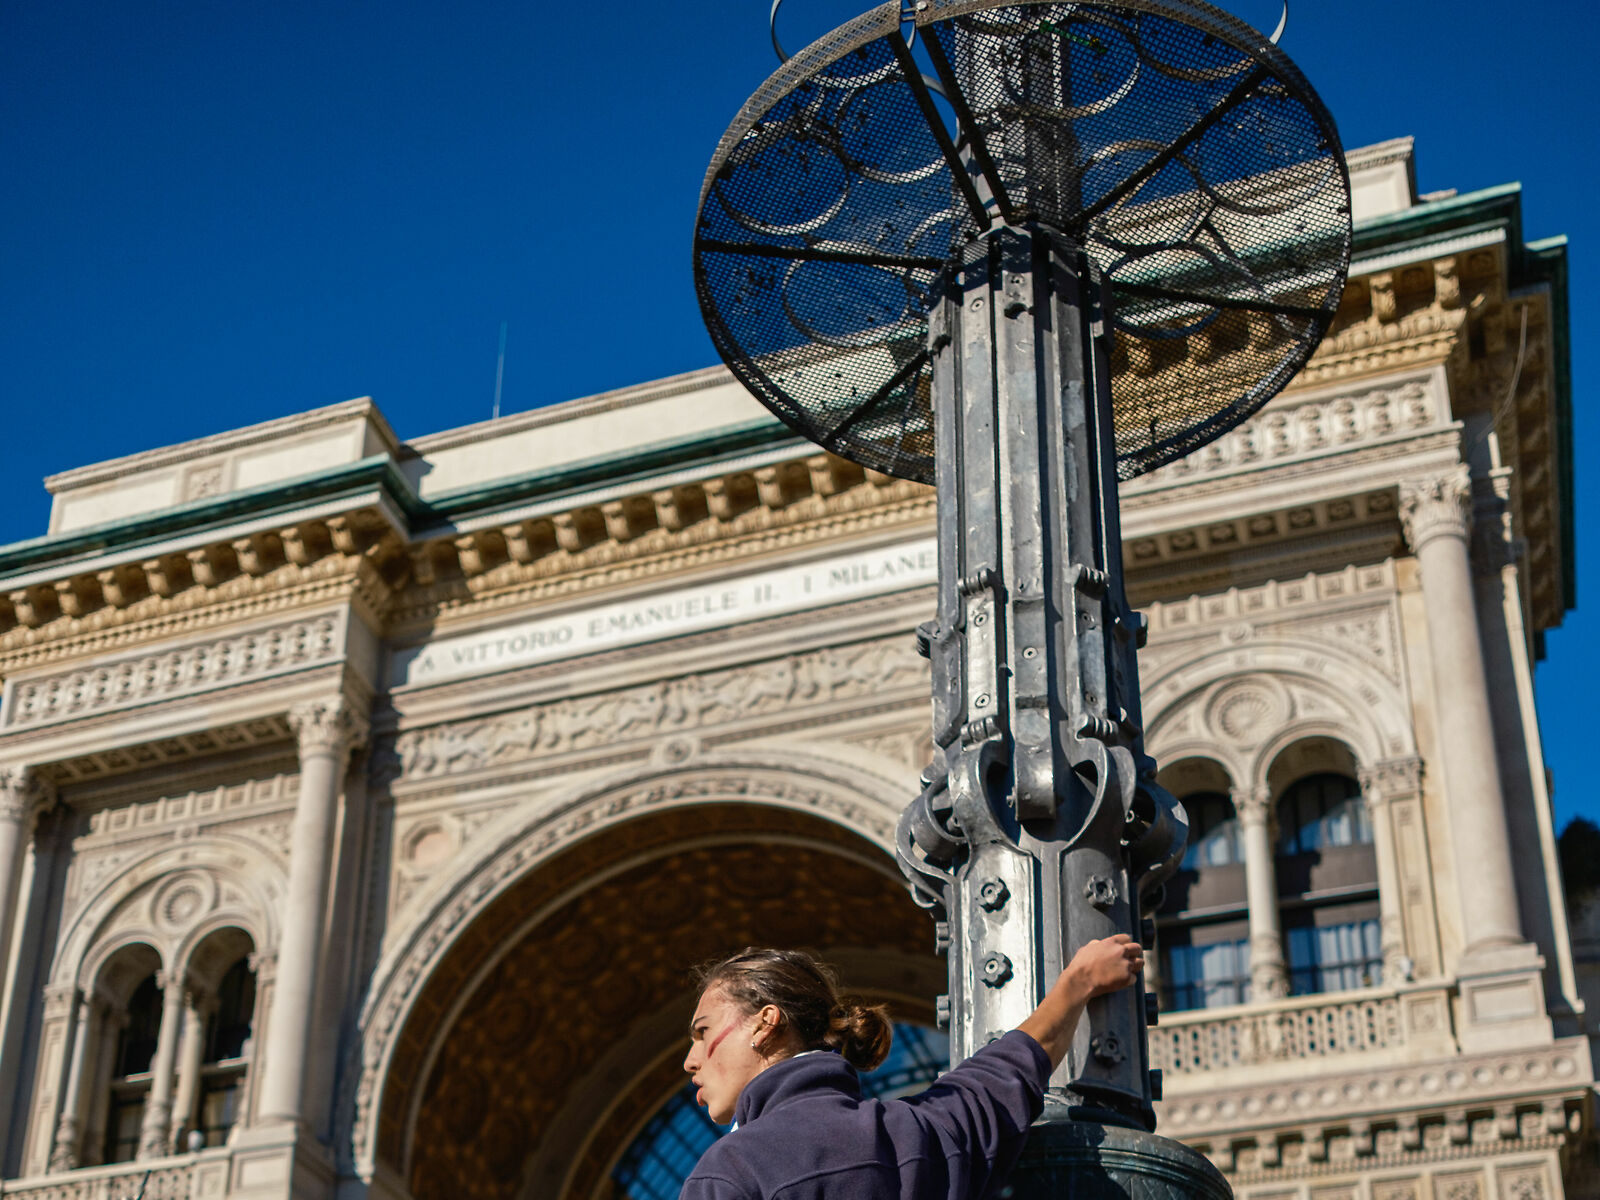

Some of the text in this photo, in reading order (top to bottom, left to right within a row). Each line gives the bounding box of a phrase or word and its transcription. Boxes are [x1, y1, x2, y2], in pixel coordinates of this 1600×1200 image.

[418, 656, 435, 673] A
[452, 626, 574, 664] VITTORIO
[587, 591, 738, 637] EMANUELE
